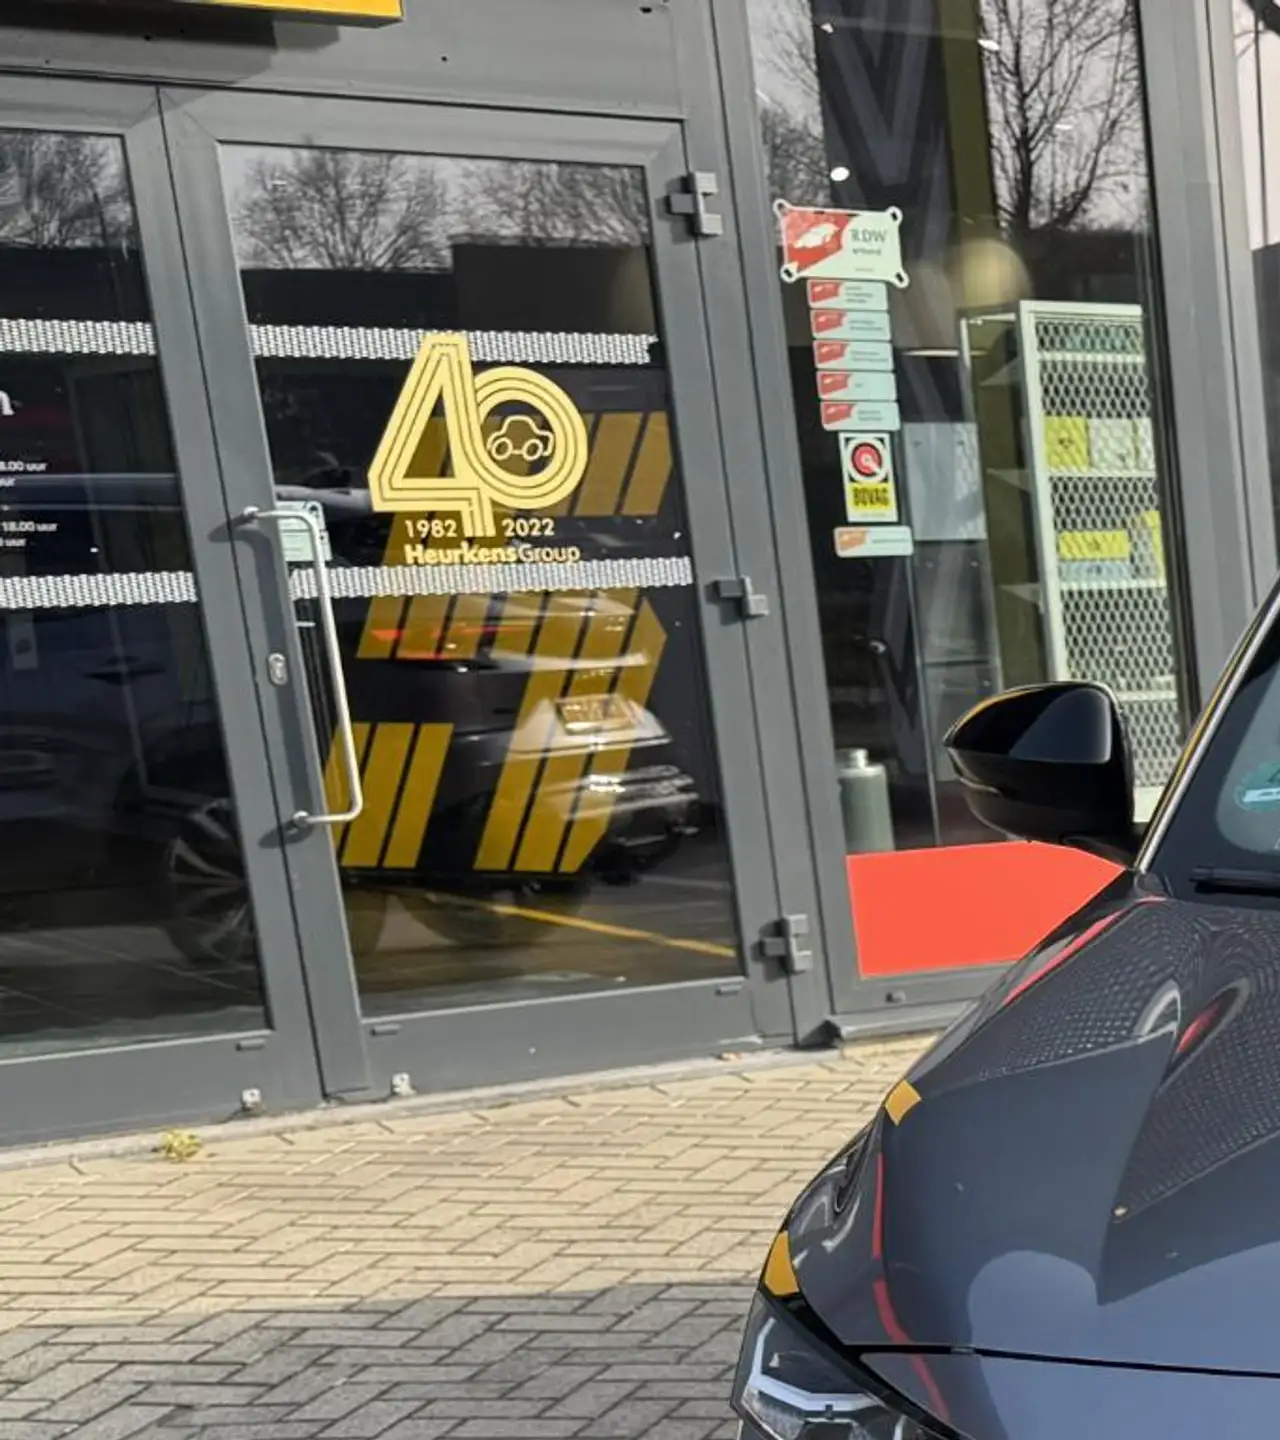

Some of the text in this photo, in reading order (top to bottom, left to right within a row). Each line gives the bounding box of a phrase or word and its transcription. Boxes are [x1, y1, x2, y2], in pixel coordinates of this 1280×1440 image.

[849, 227, 888, 244] RDW
[367, 332, 588, 537] 40
[853, 487, 890, 507] BOVAG
[404, 518, 556, 538] 1982 2022
